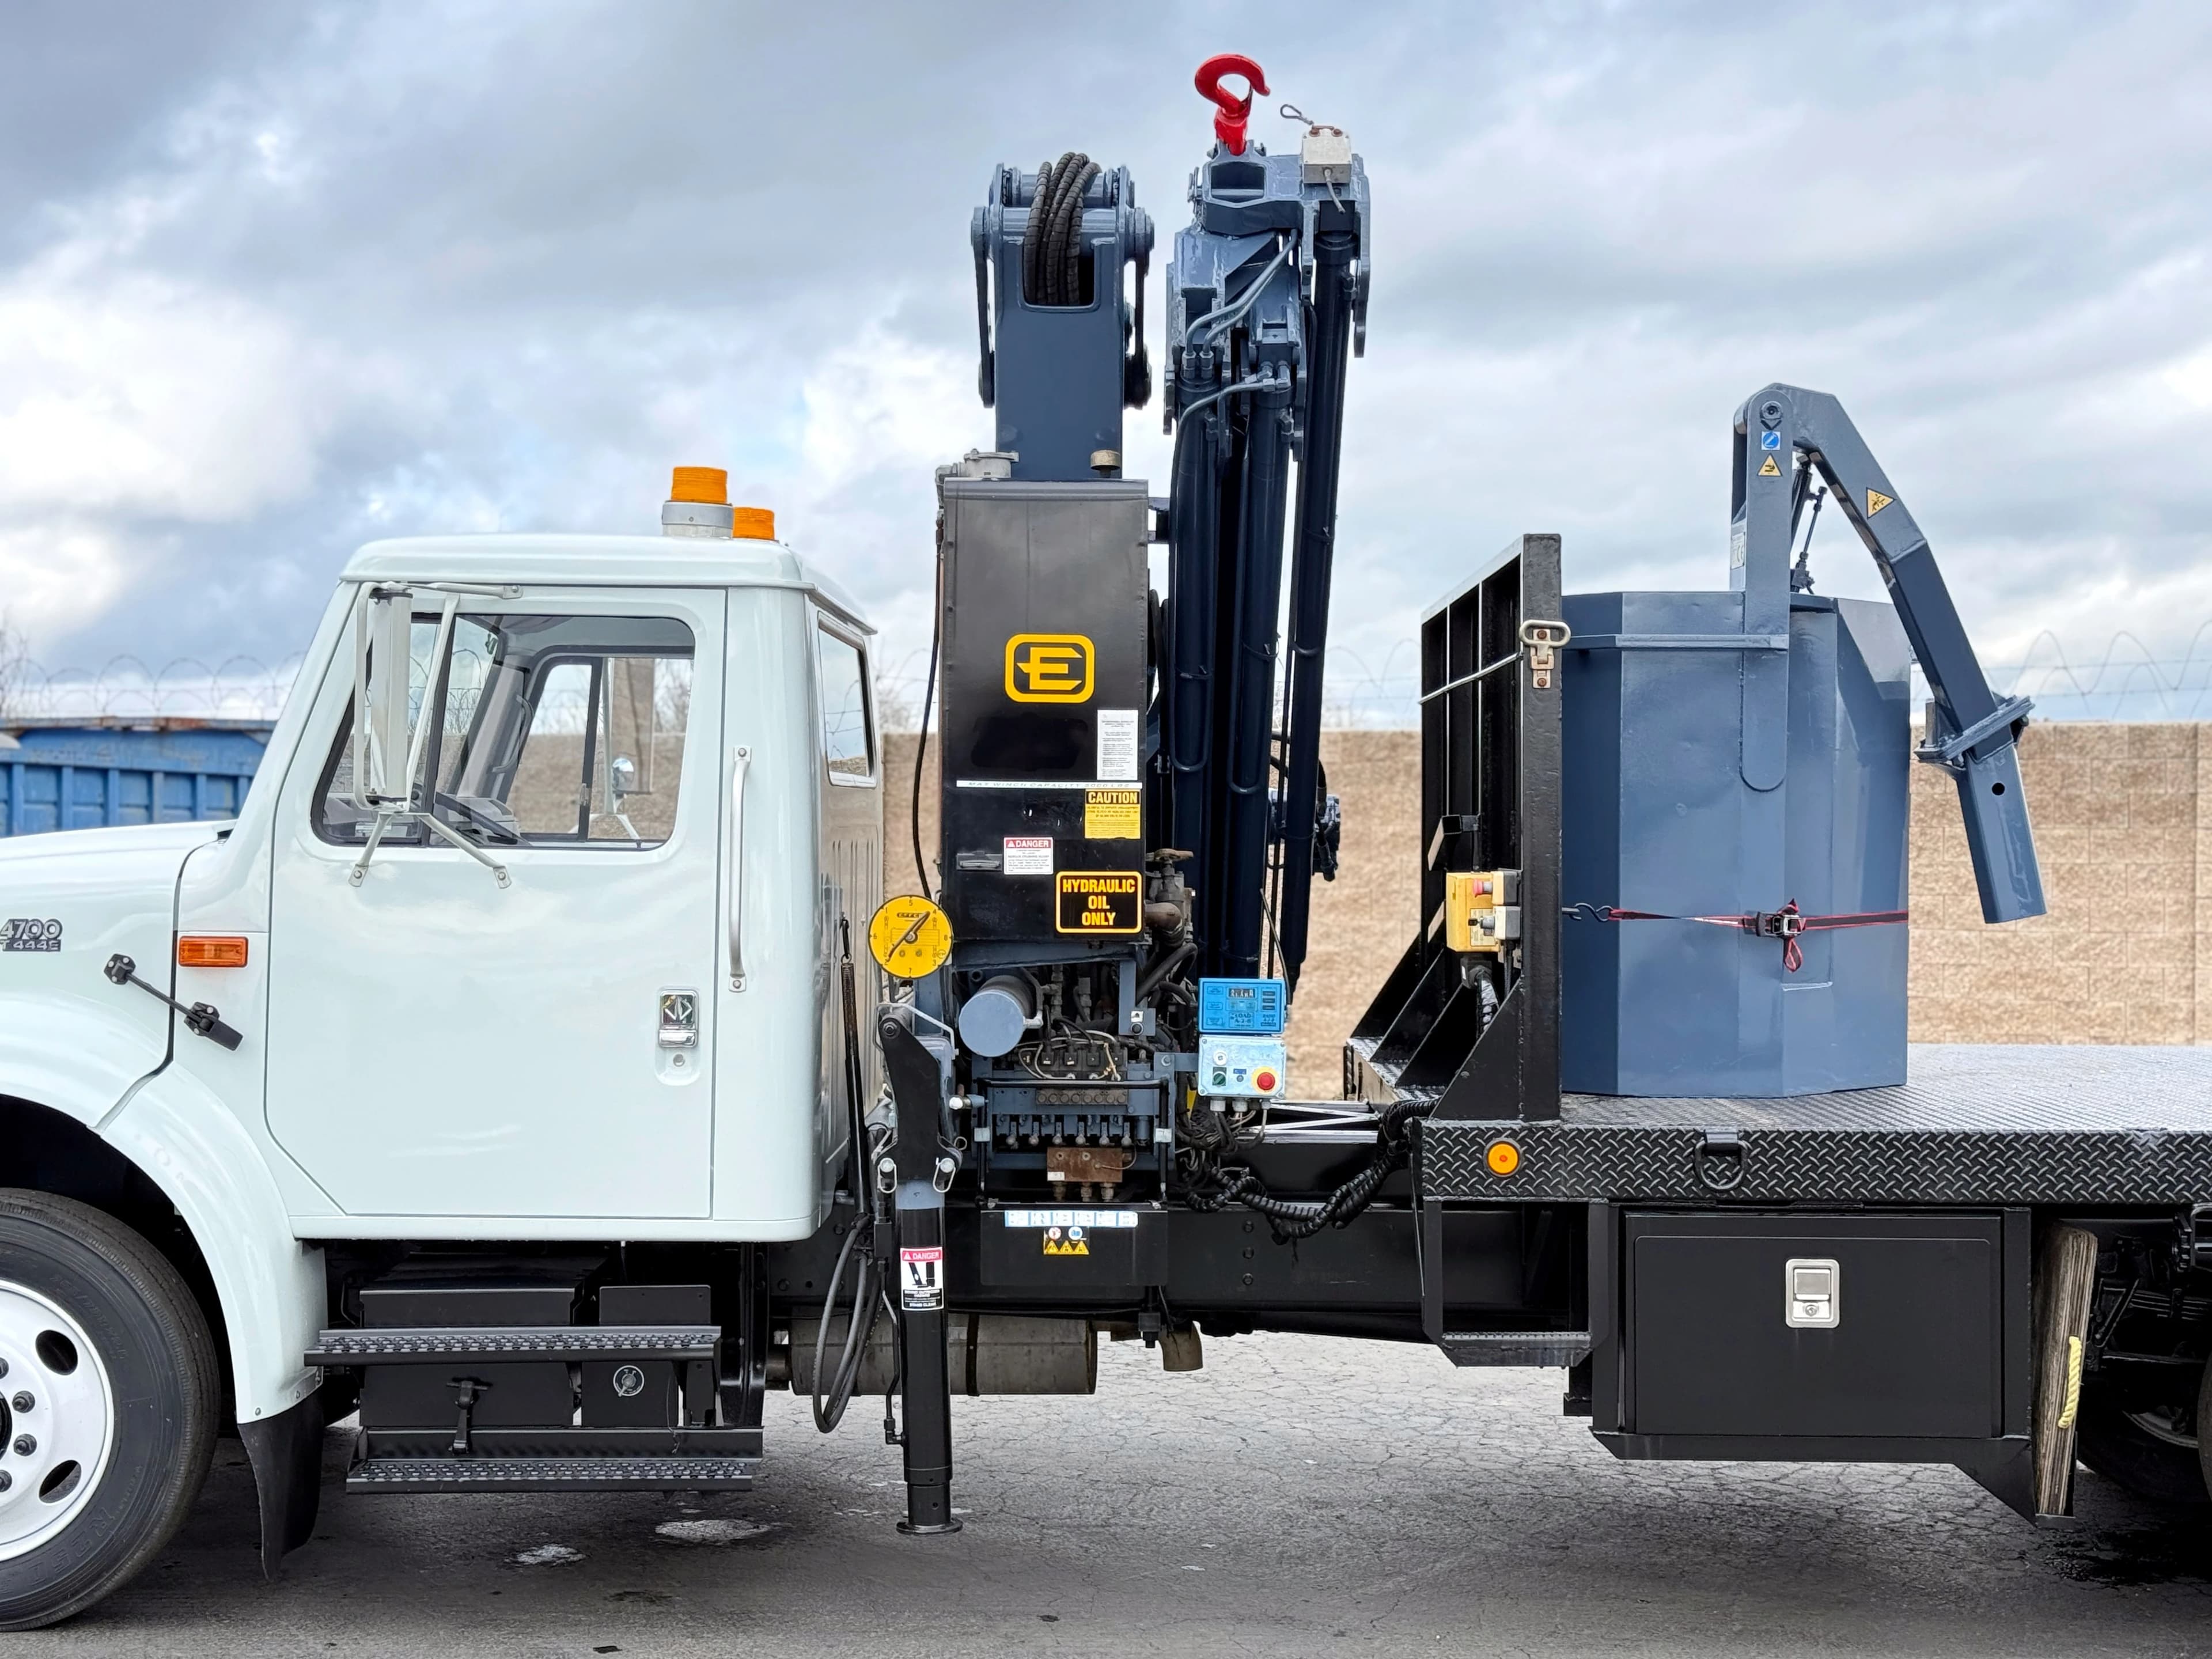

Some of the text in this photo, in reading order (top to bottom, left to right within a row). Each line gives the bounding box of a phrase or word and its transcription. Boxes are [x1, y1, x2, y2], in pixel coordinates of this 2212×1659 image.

[1088, 791, 1138, 803] CAUTION
[1016, 840, 1049, 848] DANGER
[1062, 879, 1135, 893] HYDRAULIC
[1088, 895, 1111, 910] OIL
[1081, 912, 1116, 926] ONLY
[0, 920, 62, 940] 4700
[13, 940, 59, 950] 444E
[912, 1252, 939, 1260] DANGER
